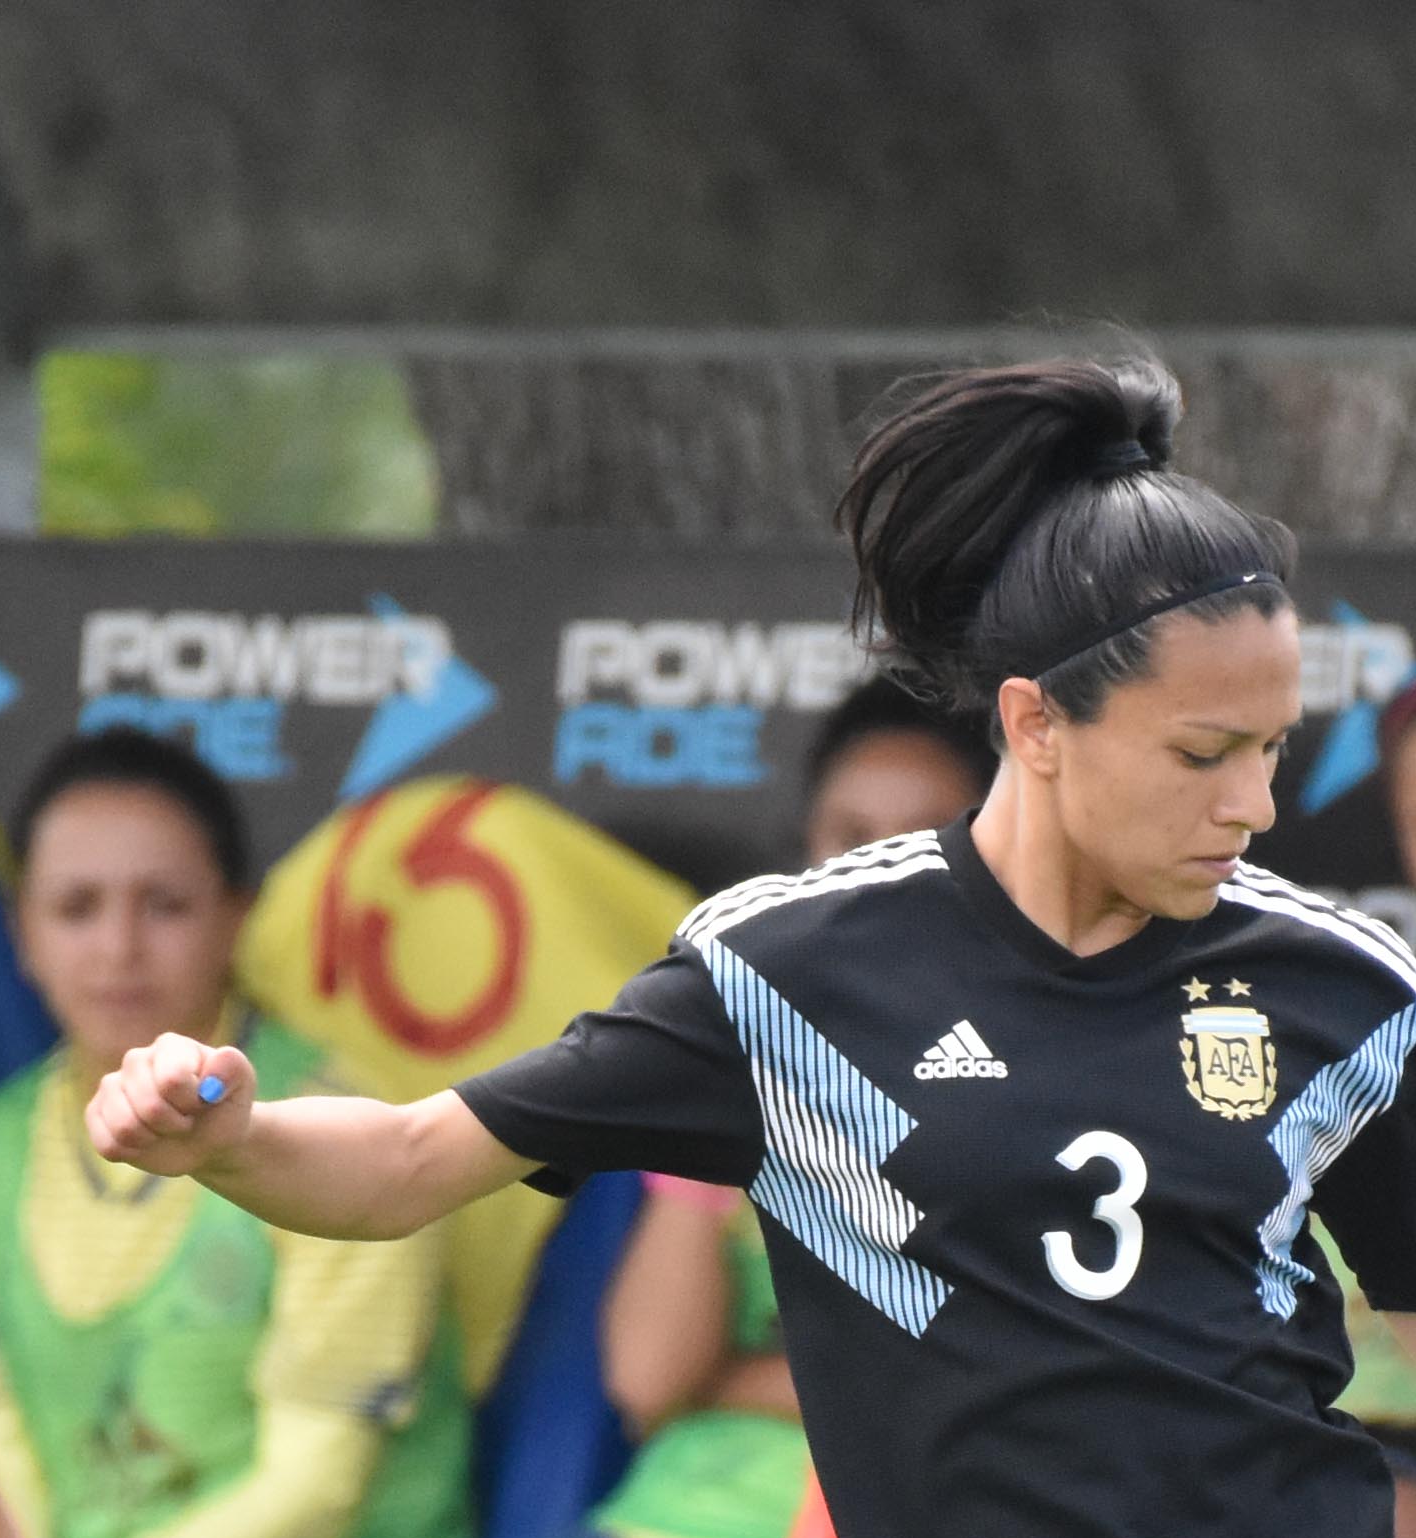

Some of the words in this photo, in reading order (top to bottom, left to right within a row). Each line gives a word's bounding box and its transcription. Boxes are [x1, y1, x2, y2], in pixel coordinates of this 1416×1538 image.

[79, 609, 453, 706] POWER
[555, 701, 765, 788] ADE
[913, 1056, 1009, 1080] adidas
[1207, 1033, 1259, 1088] AFA
[1041, 1130, 1148, 1301] 3
